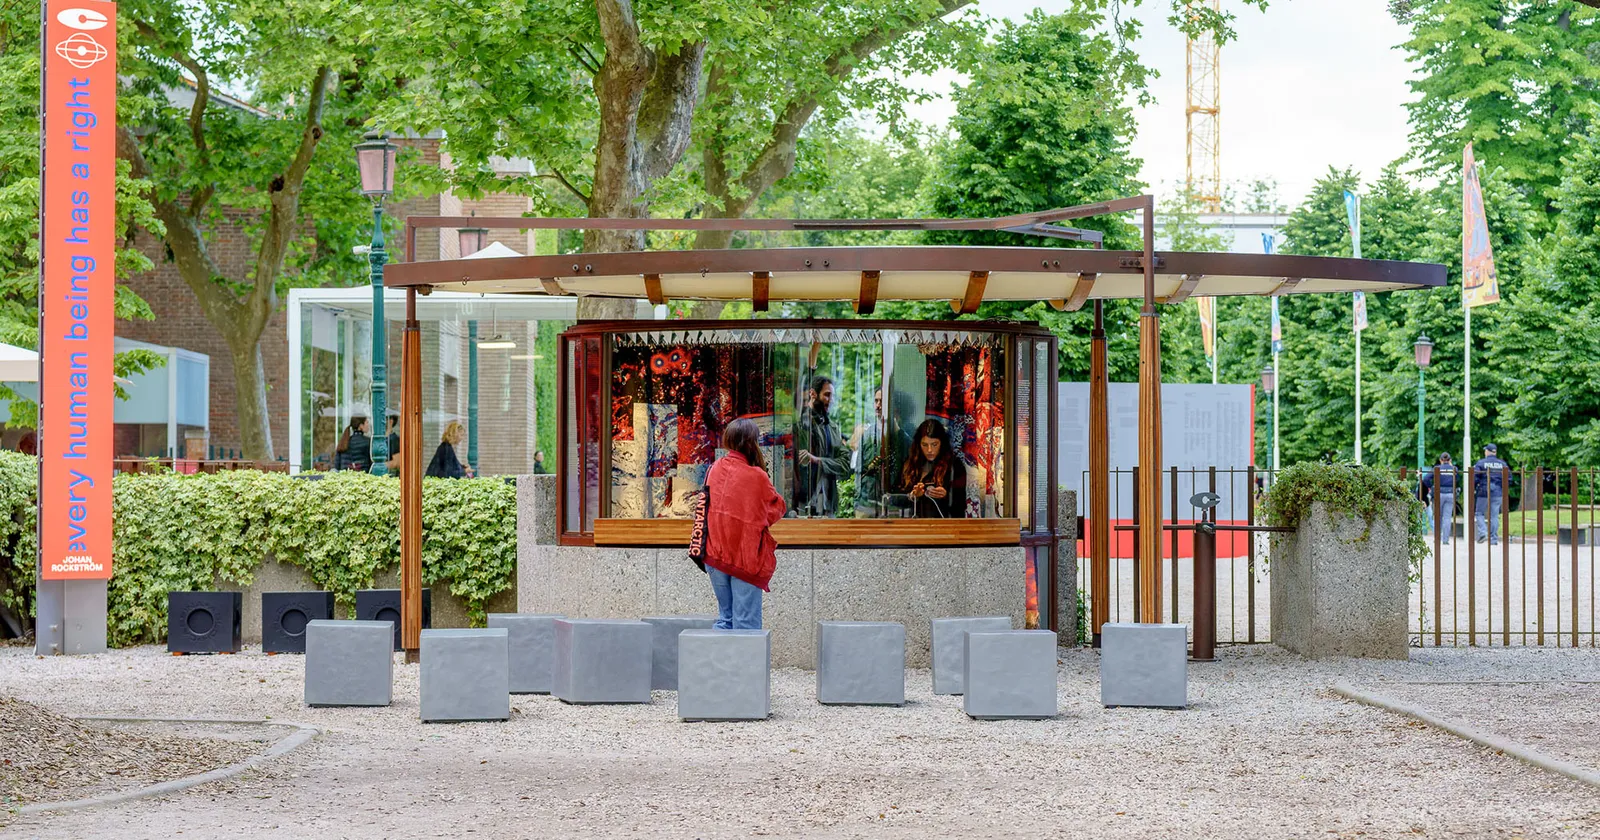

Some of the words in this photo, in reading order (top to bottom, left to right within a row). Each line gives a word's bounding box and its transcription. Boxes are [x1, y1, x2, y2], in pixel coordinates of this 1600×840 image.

[65, 77, 98, 152] right
[71, 162, 90, 180] a
[65, 190, 89, 244] has
[64, 255, 97, 341] being
[63, 352, 89, 459] human
[690, 492, 706, 556] ANTARCTIC
[51, 563, 103, 572] ROCKSTRÖM
[62, 556, 92, 564] JOHAN
